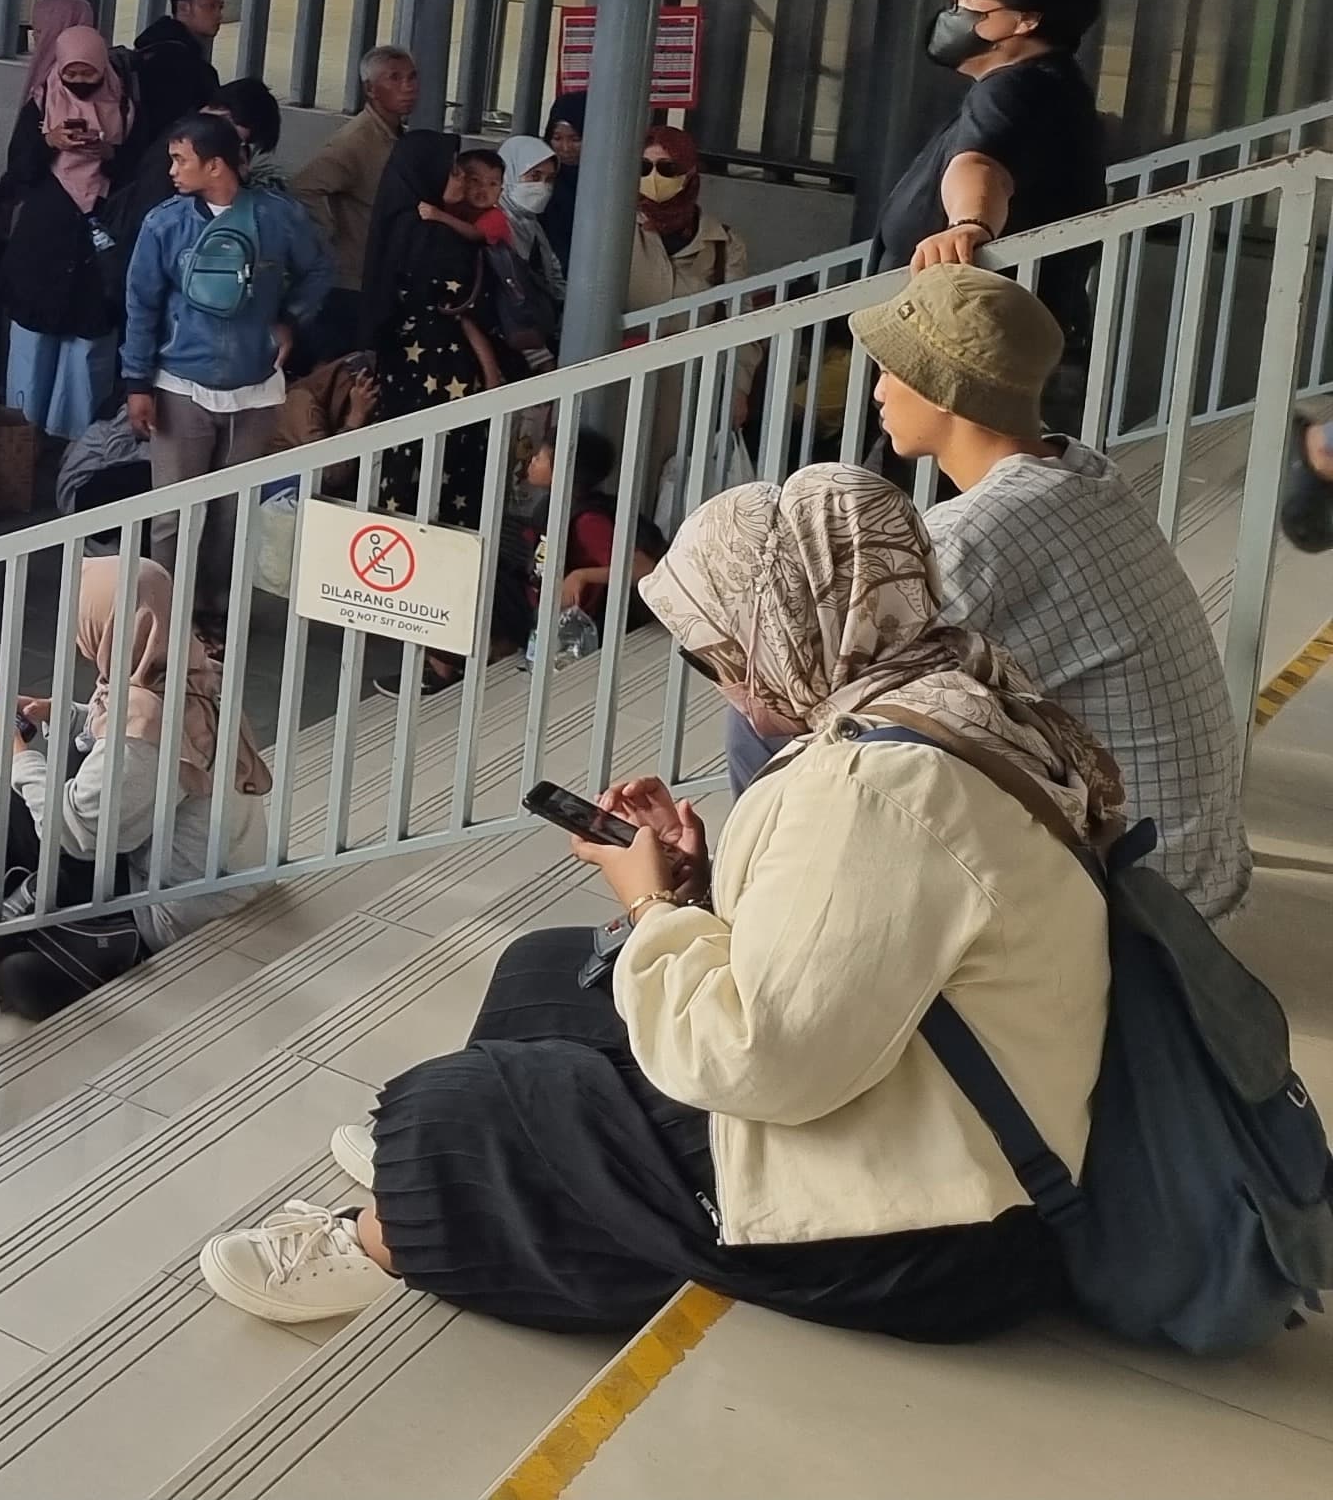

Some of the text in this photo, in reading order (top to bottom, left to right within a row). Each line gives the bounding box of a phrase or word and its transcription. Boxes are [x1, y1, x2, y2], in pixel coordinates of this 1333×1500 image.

[321, 583, 450, 621] DILARANG DUDUK
[340, 608, 429, 635] DO NOT SIT DOW
